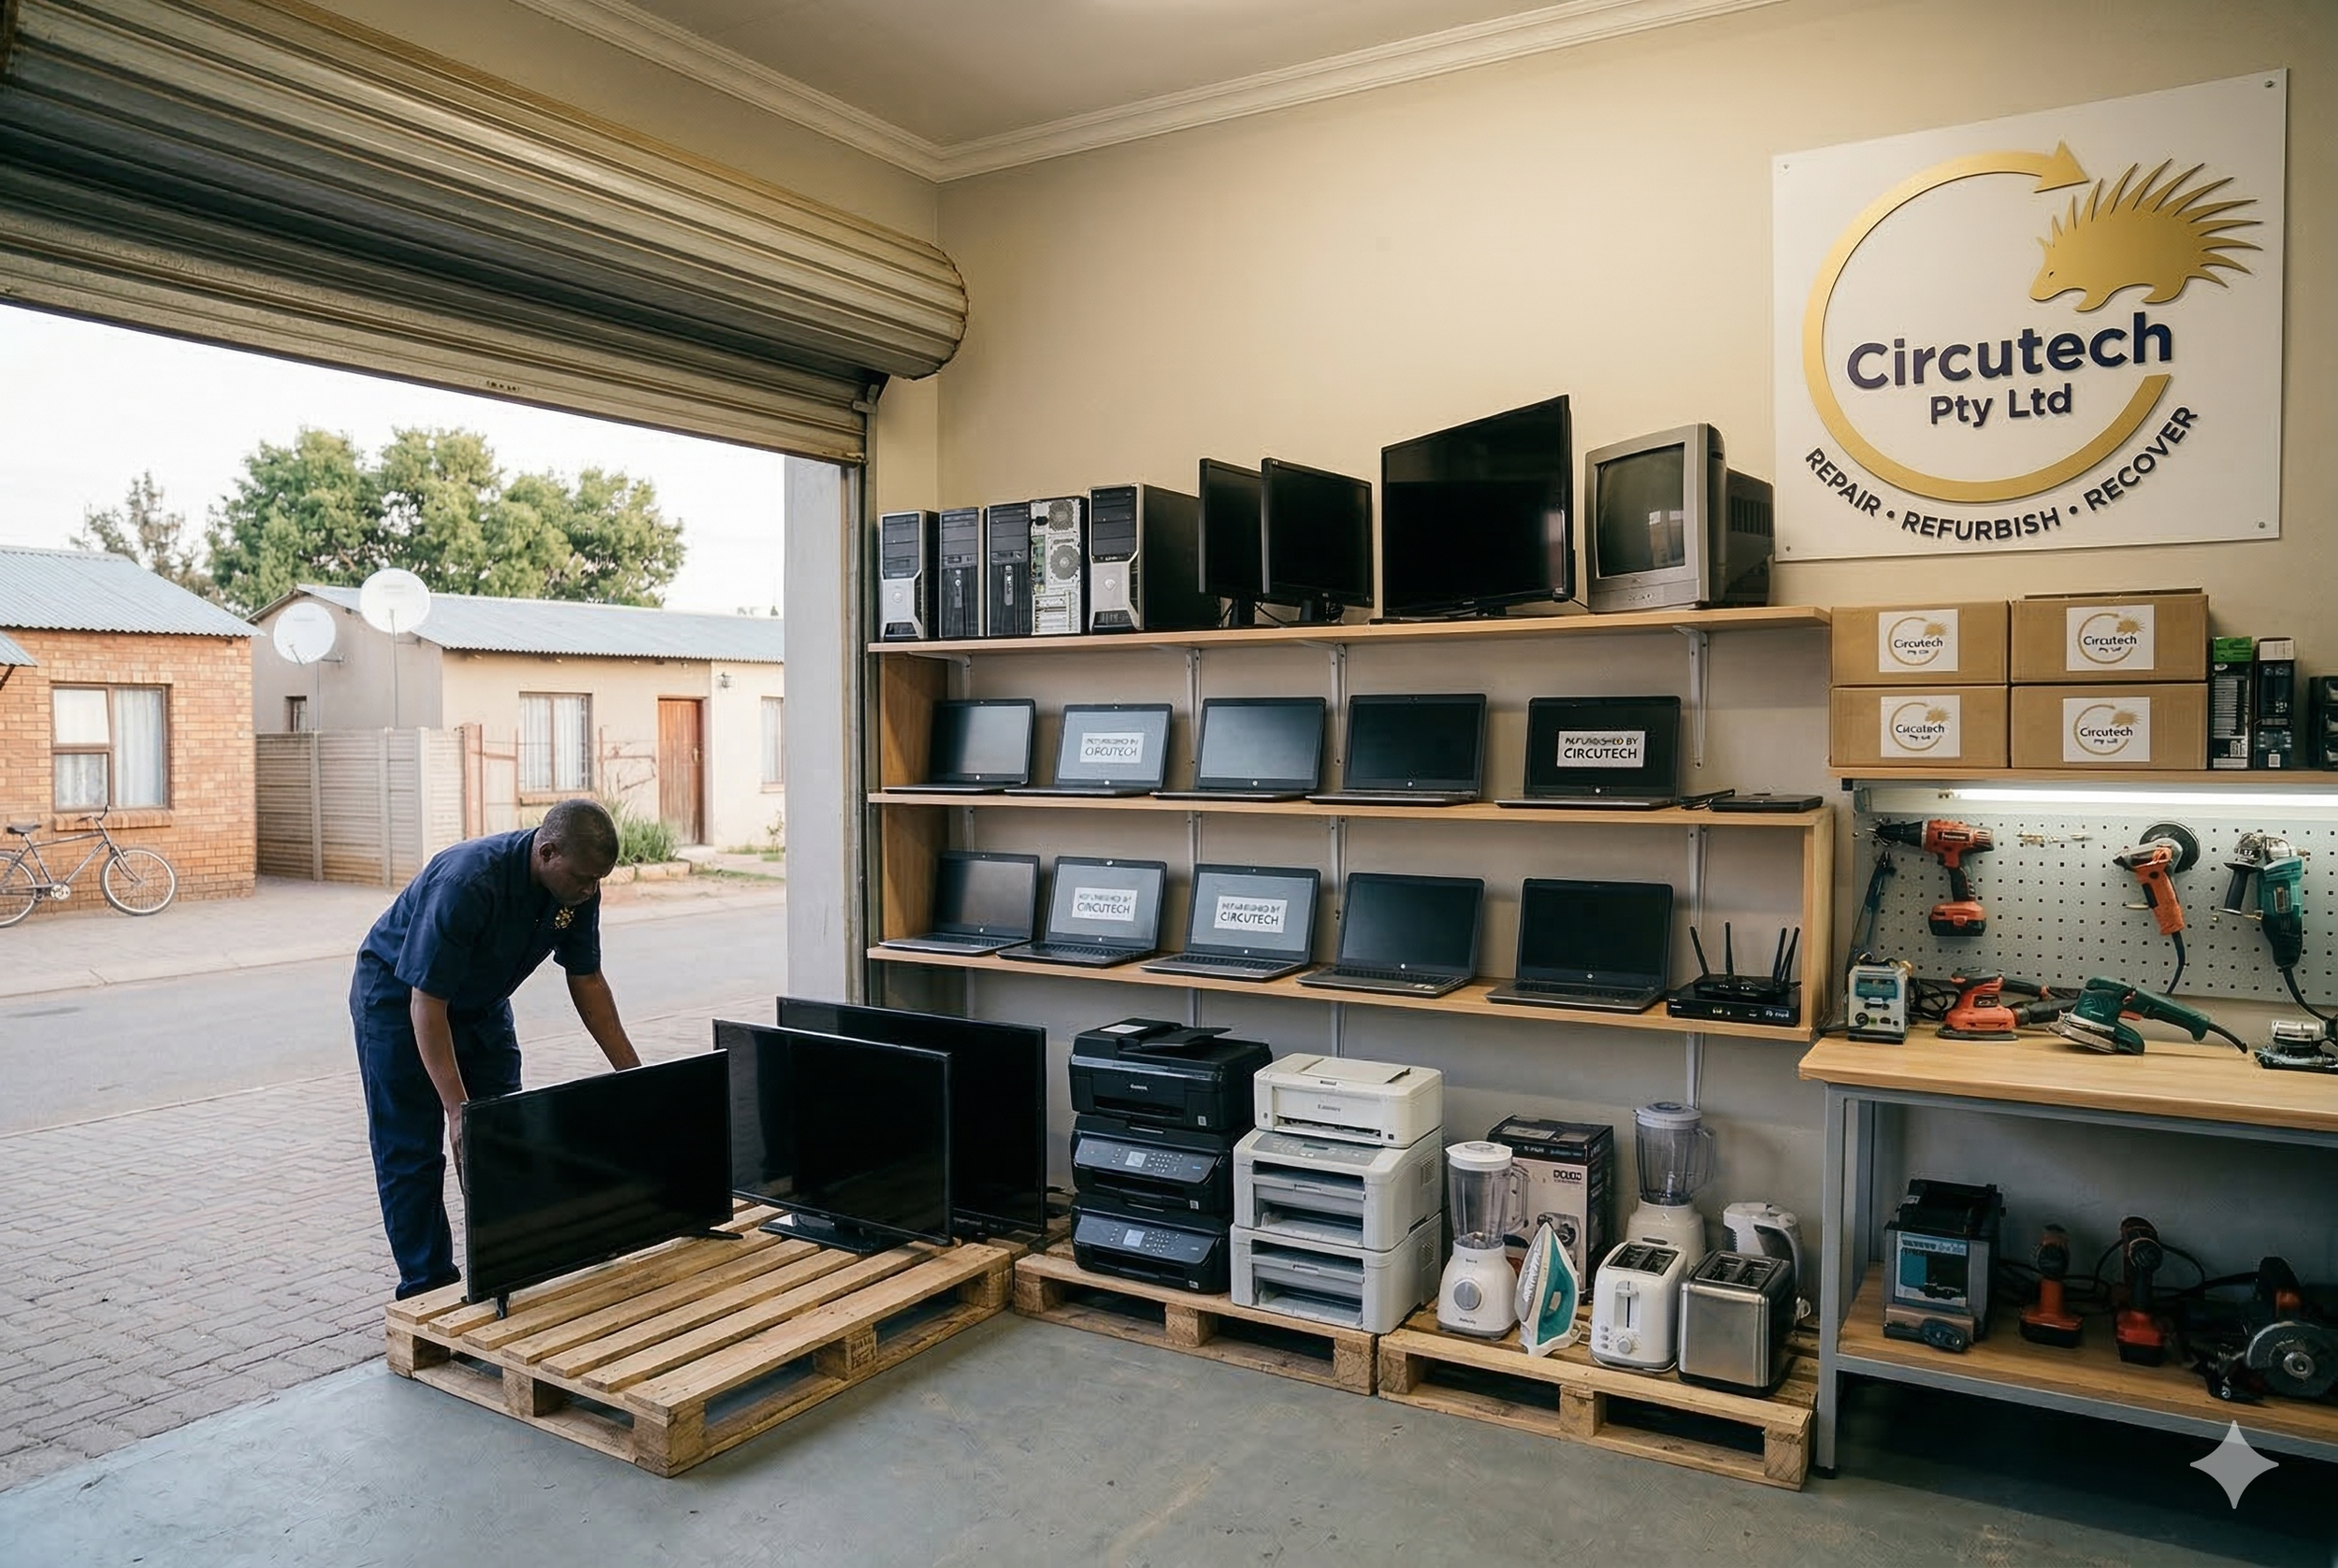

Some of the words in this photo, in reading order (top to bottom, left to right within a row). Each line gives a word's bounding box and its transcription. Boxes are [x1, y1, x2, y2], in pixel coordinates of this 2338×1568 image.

[1847, 311, 2172, 389] Circutech
[1930, 395, 1993, 427] Pty
[2008, 383, 2071, 419] Ltd
[1805, 448, 1882, 518] REPAIR
[1901, 506, 2062, 541] REFURBISH
[2083, 405, 2199, 511] RECOVER
[1564, 747, 1638, 759] CIRCUTECH
